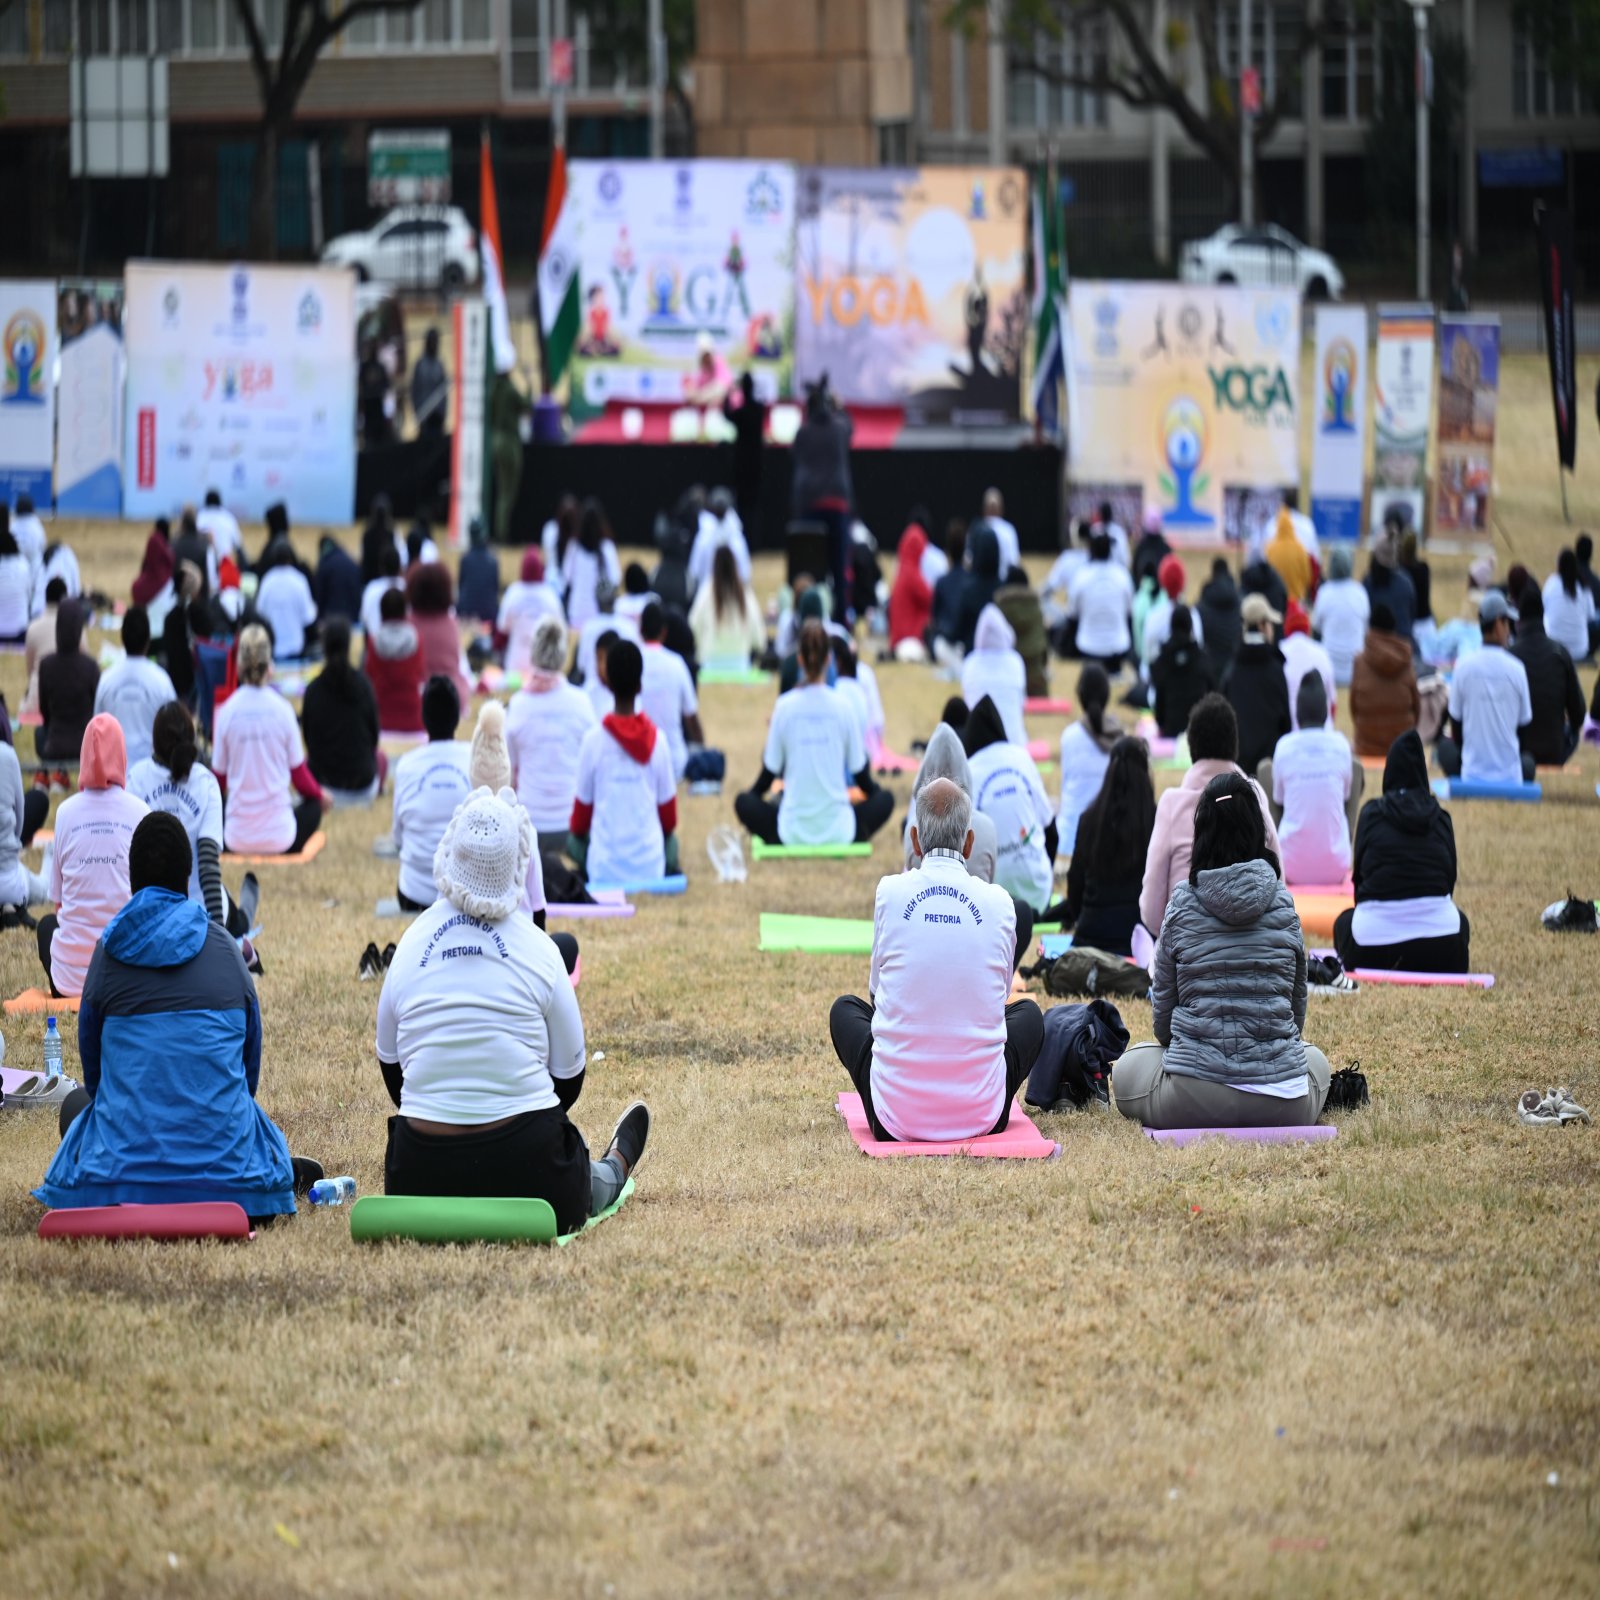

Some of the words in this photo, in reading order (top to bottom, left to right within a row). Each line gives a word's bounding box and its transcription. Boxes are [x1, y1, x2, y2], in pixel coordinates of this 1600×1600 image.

[805, 273, 931, 328] YOGA
[1206, 365, 1293, 412] YOGA
[152, 782, 200, 818] COMMISSION
[903, 898, 918, 921] HIGH
[916, 885, 959, 903] COMMISSION
[959, 893, 969, 904] OF
[967, 901, 983, 926] INDIA
[924, 913, 961, 924] PRETORIA
[419, 942, 435, 968] HIGH
[433, 914, 482, 942] COMMISSION
[482, 922, 494, 935] OF
[492, 932, 509, 960] INDIA
[441, 945, 483, 960] PRETORIA
